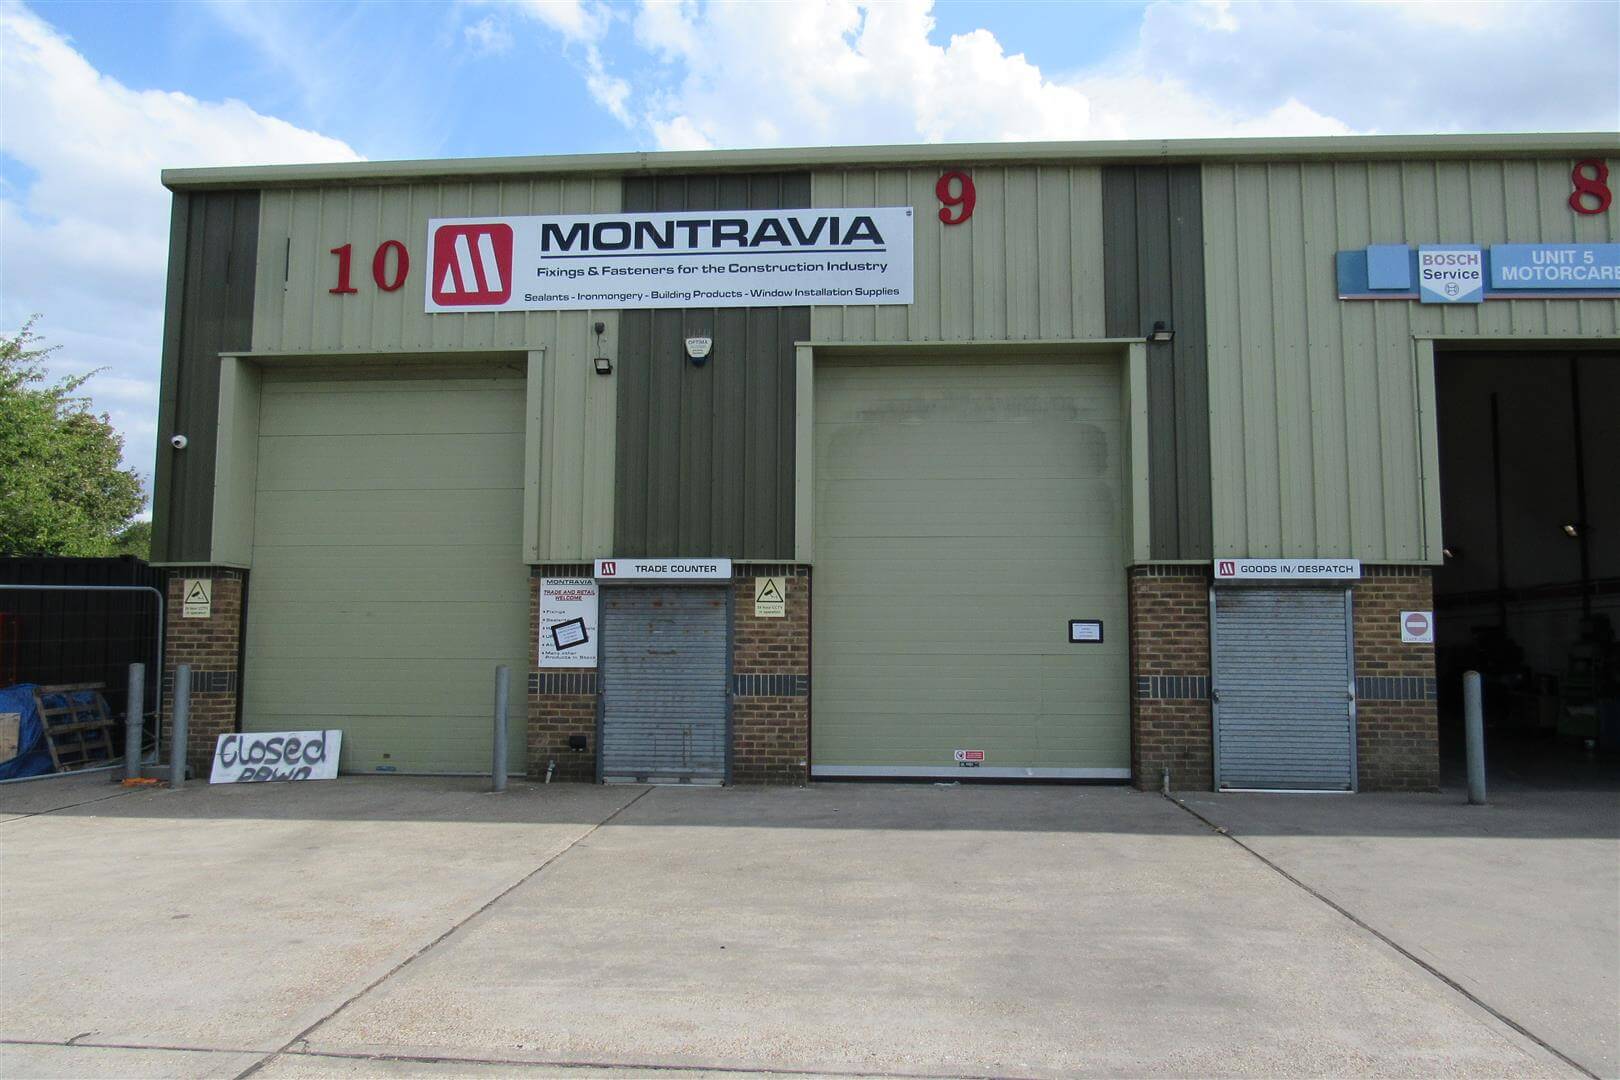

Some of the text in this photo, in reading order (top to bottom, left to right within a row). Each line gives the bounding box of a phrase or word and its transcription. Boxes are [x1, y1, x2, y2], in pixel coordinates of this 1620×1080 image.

[1569, 158, 1612, 214] 8
[936, 171, 976, 225] 9
[541, 216, 885, 251] MONTRAVIA
[1423, 254, 1478, 265] BOSCH
[1532, 250, 1594, 264] UNIT 5
[328, 240, 410, 293] 10
[537, 261, 888, 279] Fixings & Fasteners for the Construction Industry
[1423, 269, 1480, 280] Service
[524, 293, 569, 301] Sealants
[577, 292, 643, 301] Ironmongery
[651, 291, 691, 300] Building
[693, 290, 743, 299] Products
[750, 289, 793, 298] Window
[795, 288, 853, 297] Installation
[855, 287, 900, 298] Supplies
[635, 565, 717, 573] TRADE COUNTER
[1241, 565, 1354, 573] GOODS IN/DESPATCH
[221, 730, 326, 769] Closed
